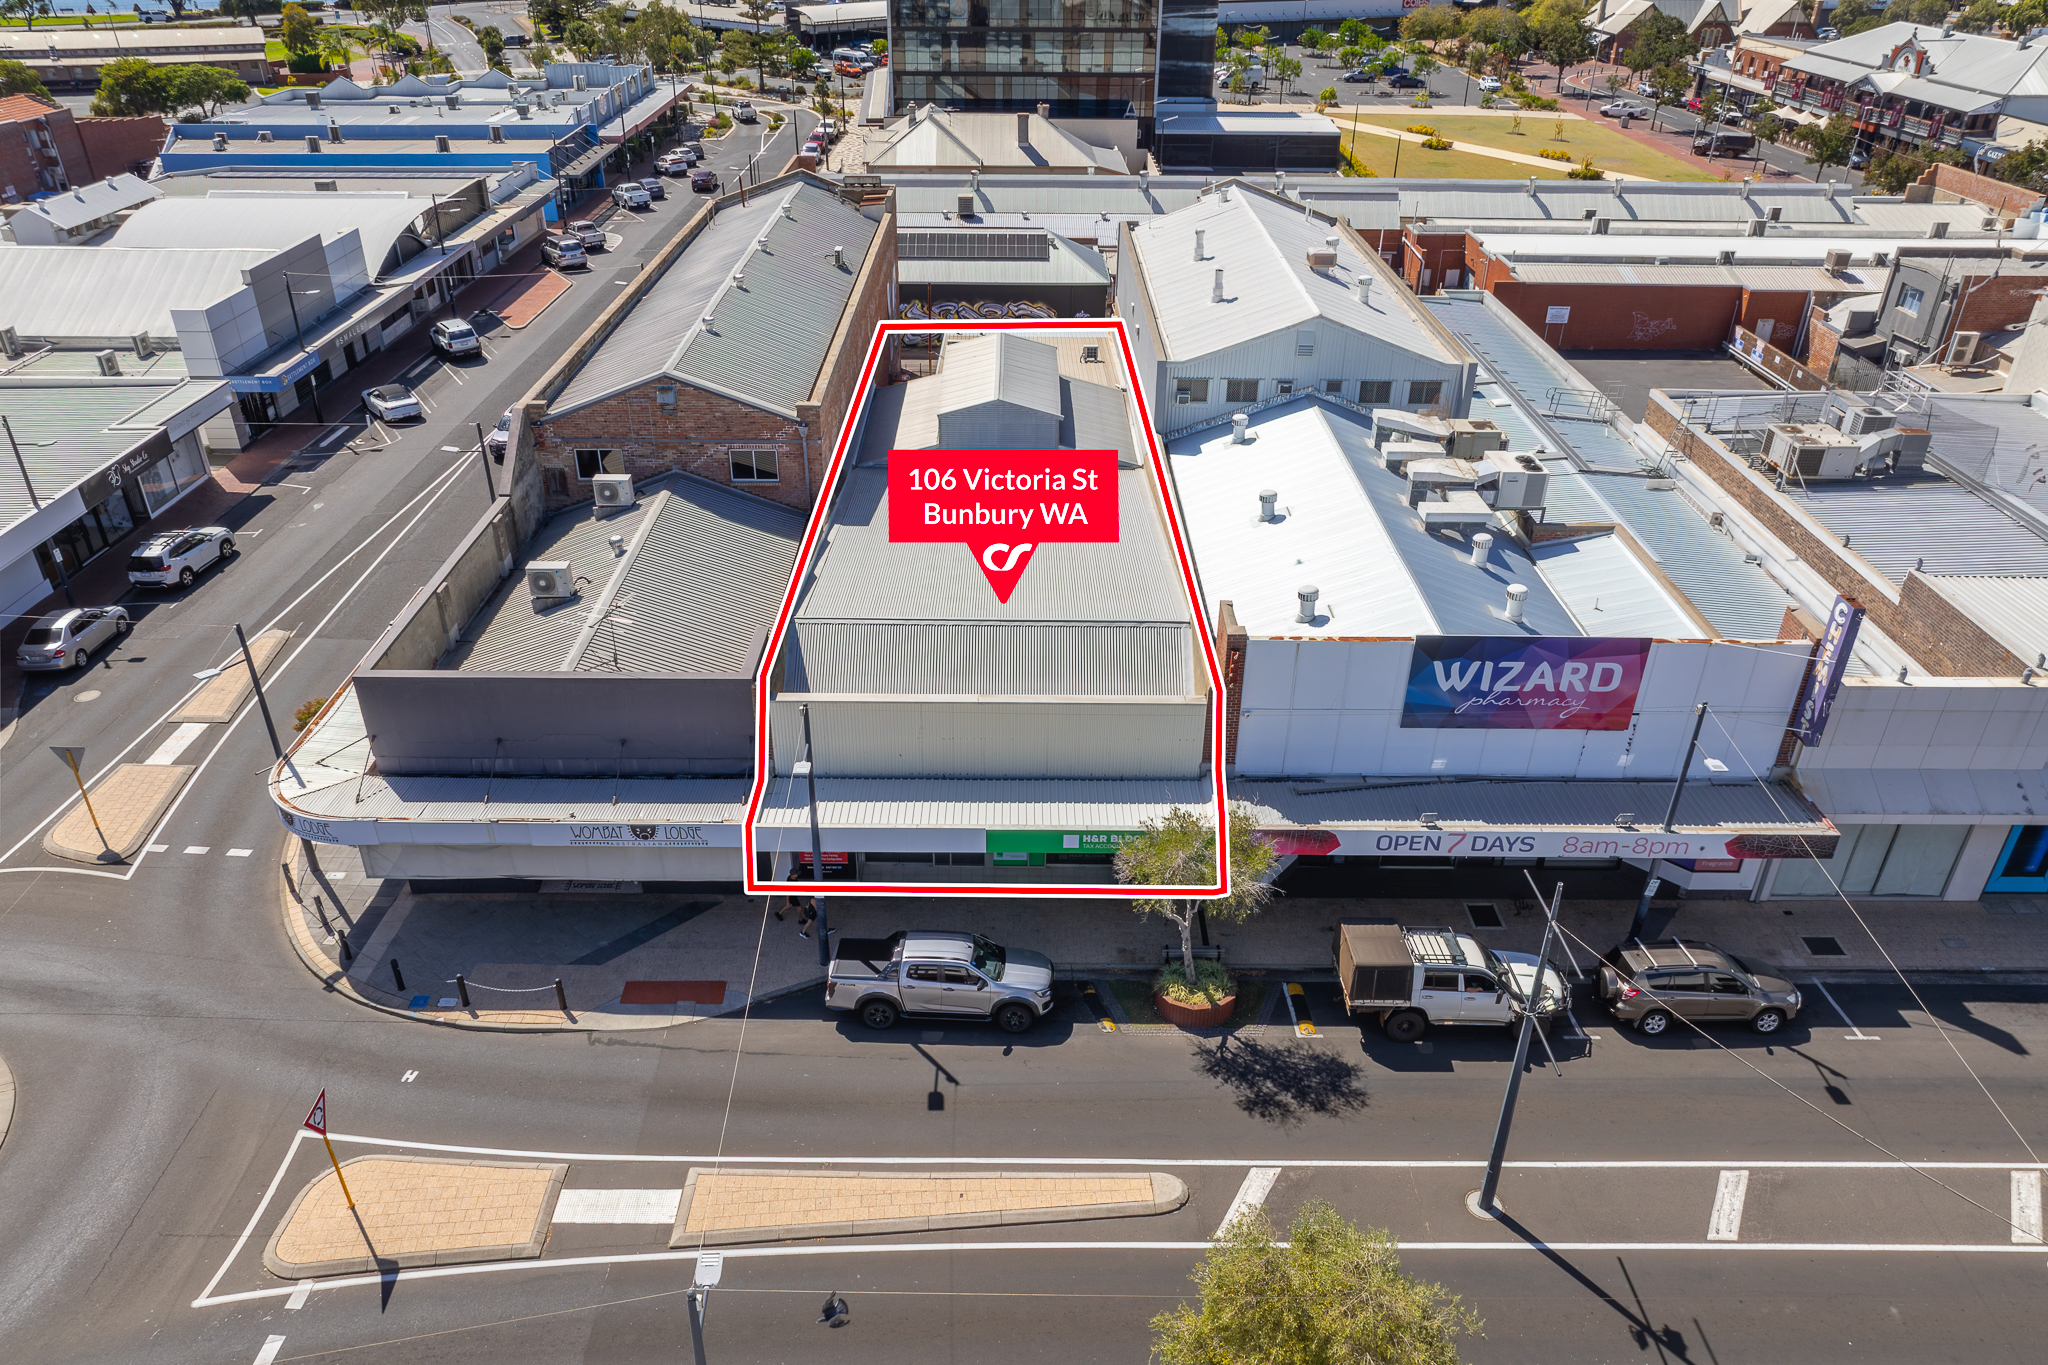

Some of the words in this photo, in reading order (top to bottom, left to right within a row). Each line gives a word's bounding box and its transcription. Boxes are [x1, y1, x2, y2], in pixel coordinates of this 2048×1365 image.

[340, 322, 364, 345] SMALES
[307, 357, 316, 366] BOX
[1433, 661, 1623, 692] WIZARD
[1800, 602, 1848, 737] CHEMIST
[1454, 688, 1590, 718] pharmacy
[298, 818, 333, 836] LODGE
[570, 826, 622, 839] WOMBAT
[664, 826, 702, 839] LODGE
[1083, 834, 1107, 843] H&R
[1376, 834, 1442, 851] OPEN
[1447, 833, 1467, 853] 7
[1471, 835, 1536, 852] DAYS
[1563, 836, 1690, 857] 8am-8pm
